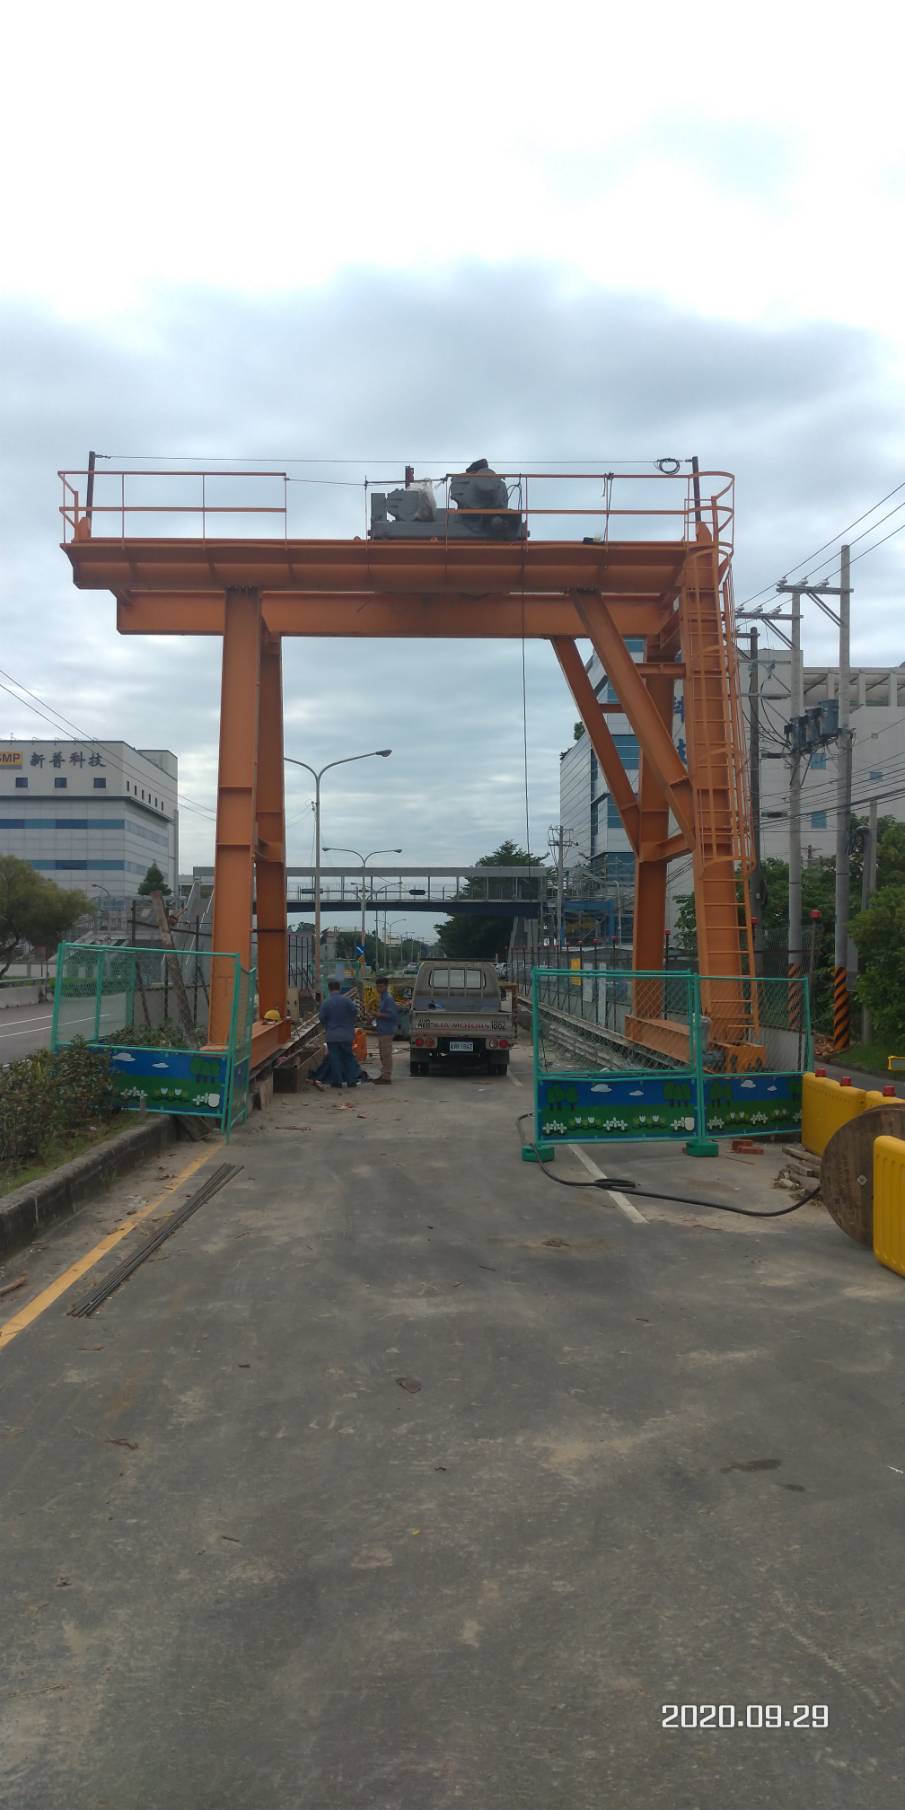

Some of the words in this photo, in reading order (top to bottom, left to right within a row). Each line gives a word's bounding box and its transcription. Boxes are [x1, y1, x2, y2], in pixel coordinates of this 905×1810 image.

[0, 752, 21, 763] MP
[30, 751, 106, 768] 新普科技
